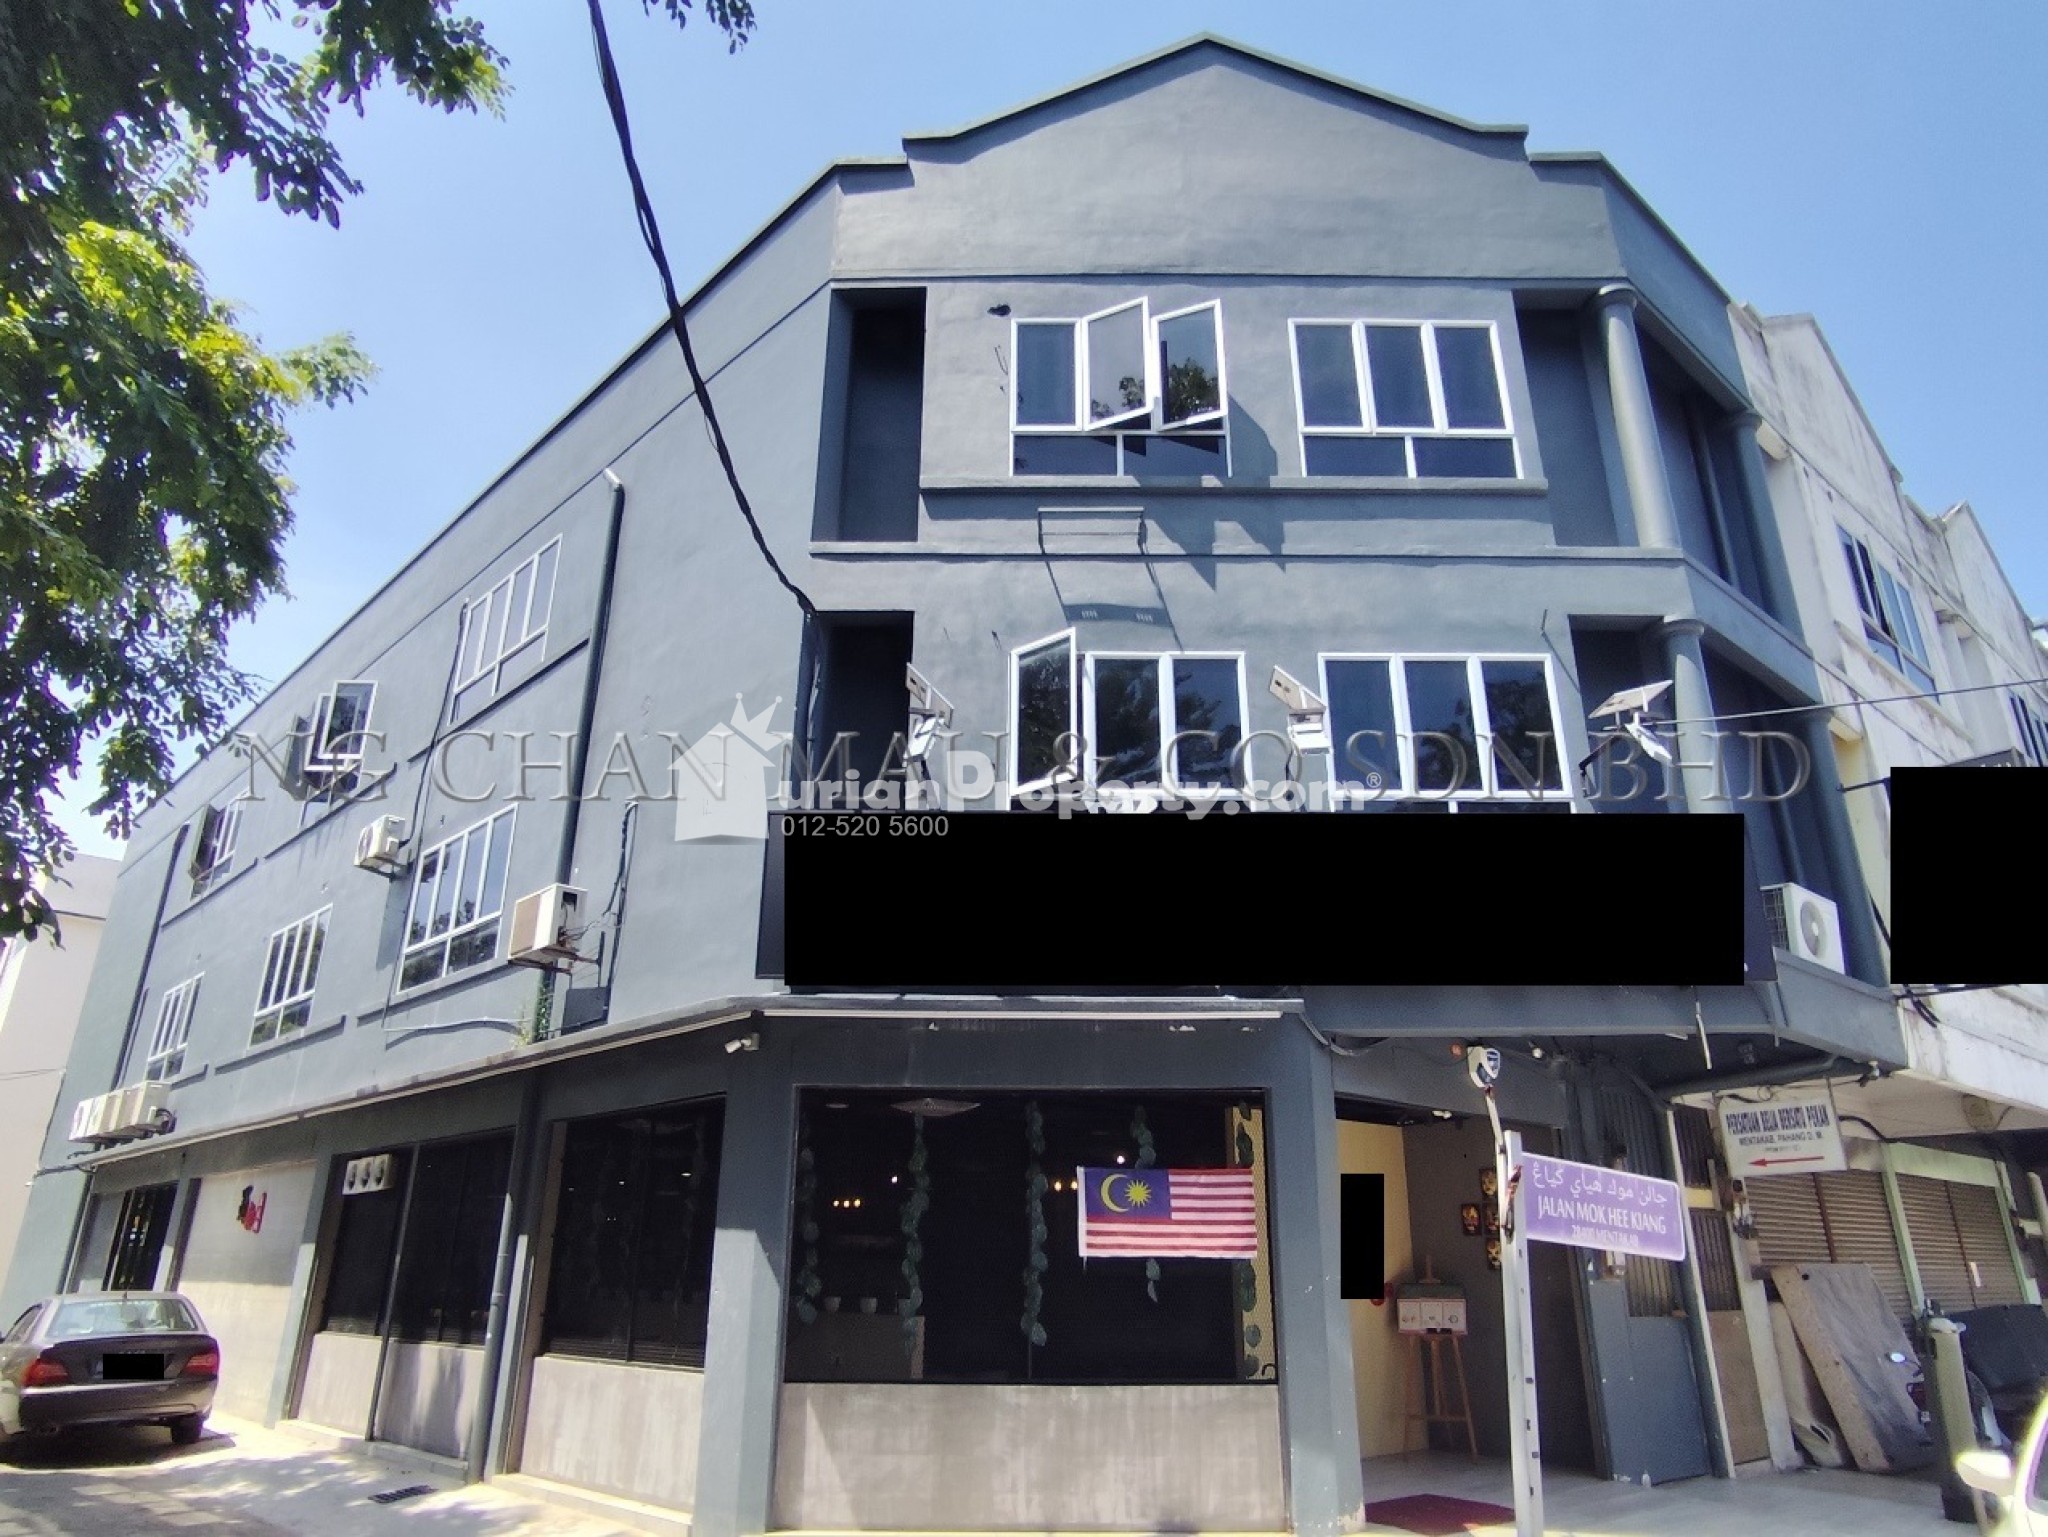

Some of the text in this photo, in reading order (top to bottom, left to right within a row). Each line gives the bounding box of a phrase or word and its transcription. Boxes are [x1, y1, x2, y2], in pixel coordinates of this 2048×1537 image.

[1537, 1195, 1667, 1235] JALAN MOK HEE KIANG
